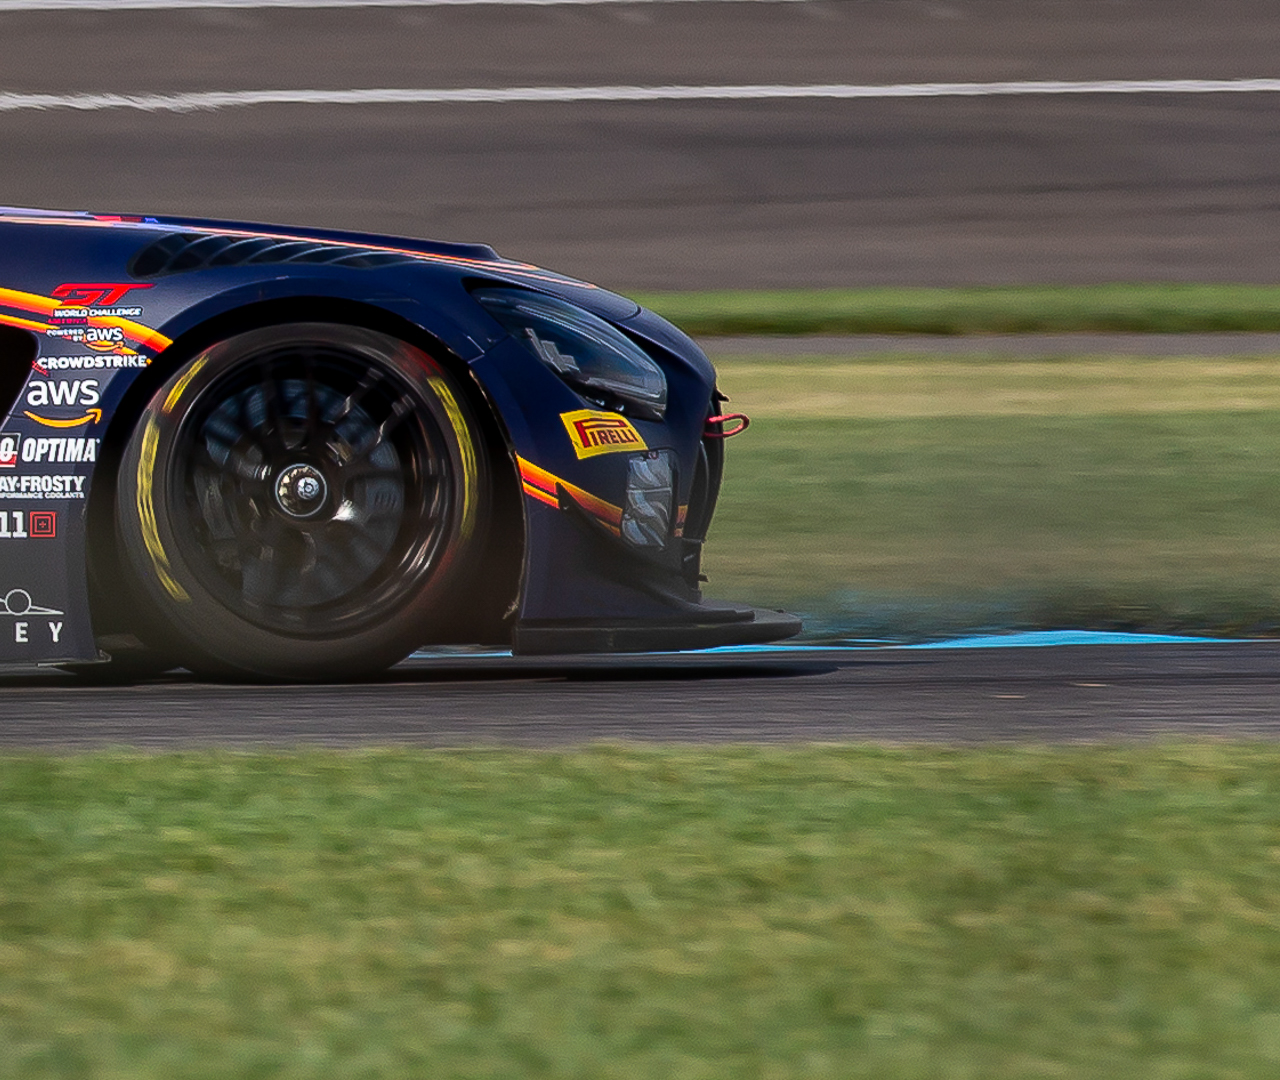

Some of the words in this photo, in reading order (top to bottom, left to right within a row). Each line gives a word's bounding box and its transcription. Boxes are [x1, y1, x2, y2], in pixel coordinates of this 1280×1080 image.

[54, 309, 88, 318] WORLD
[89, 307, 142, 317] CHALLENGE
[86, 328, 124, 341] aws
[37, 355, 148, 370] CROWDSTRIKE
[26, 380, 101, 406] aws
[573, 418, 639, 448] PIRELLI
[21, 437, 97, 462] OPTIMA
